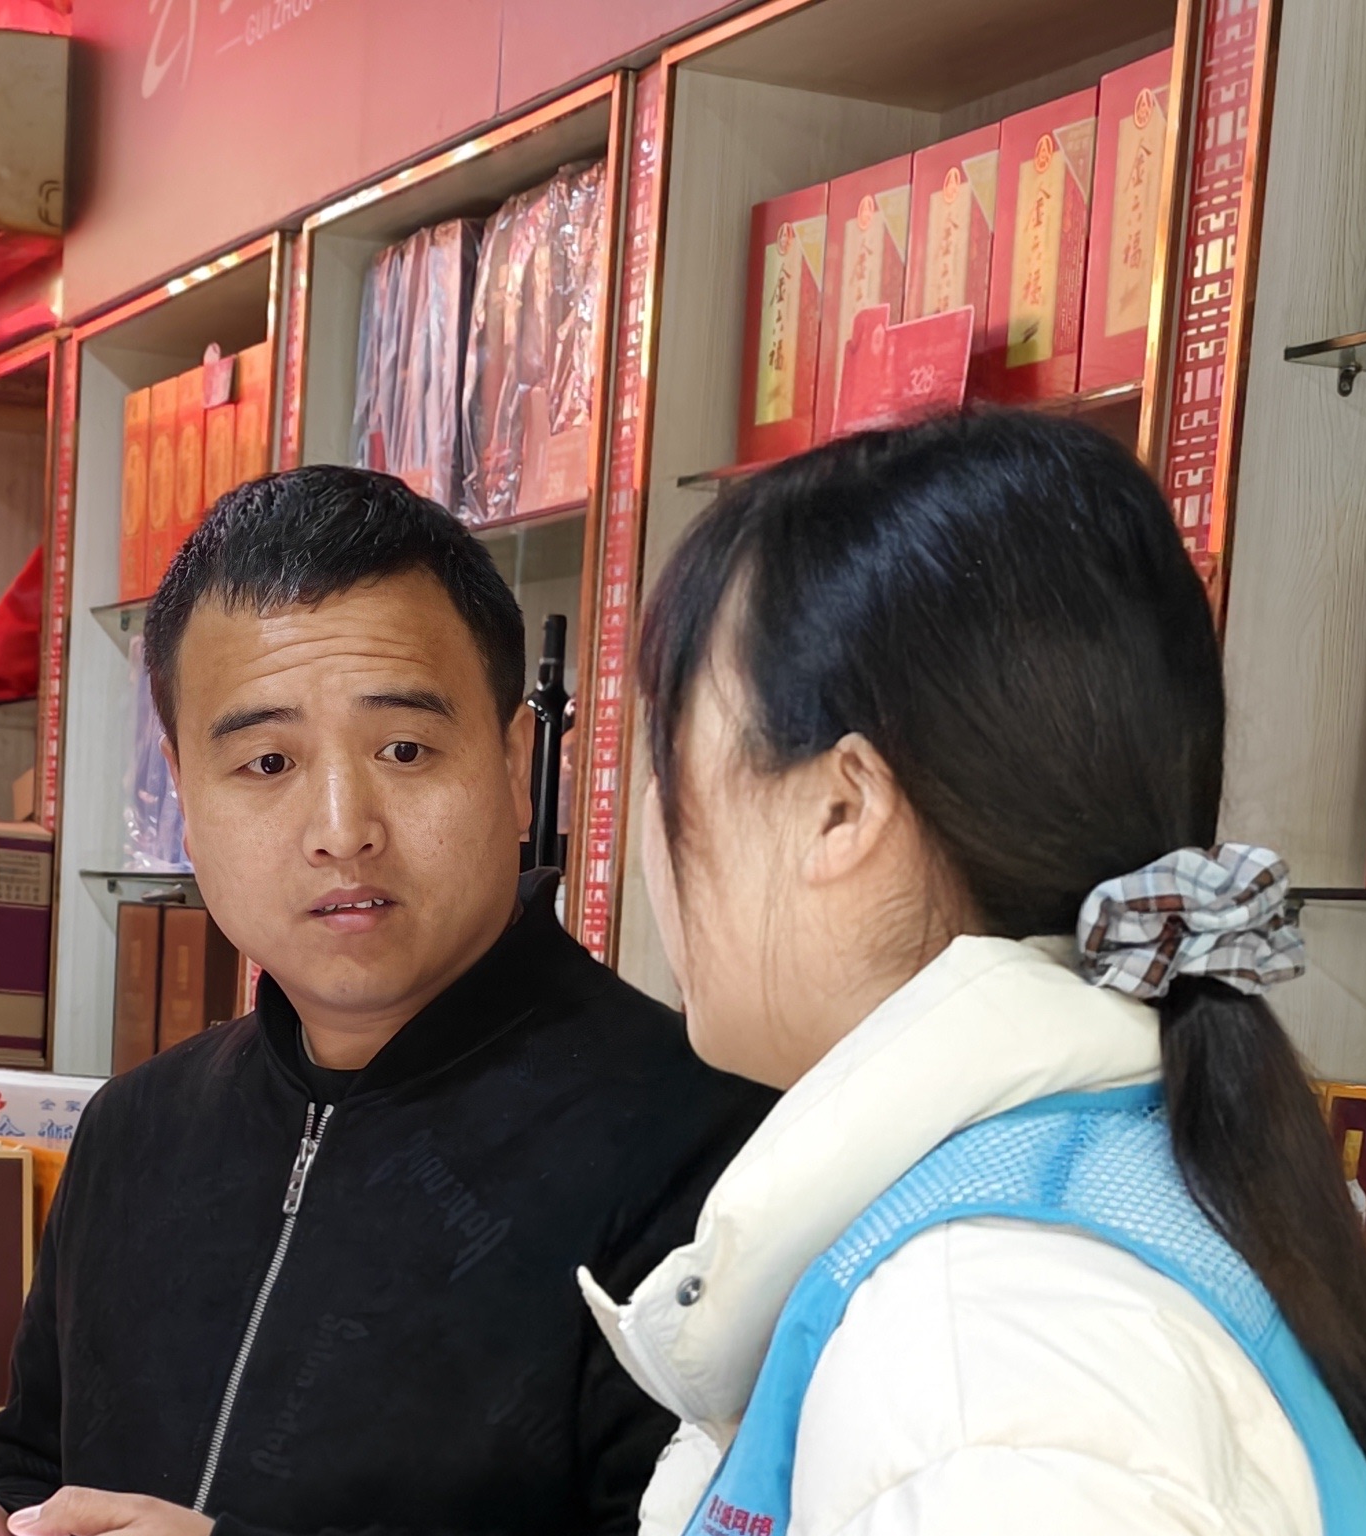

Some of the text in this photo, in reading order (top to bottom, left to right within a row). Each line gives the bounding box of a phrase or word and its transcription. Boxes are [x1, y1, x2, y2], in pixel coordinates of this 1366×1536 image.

[1022, 186, 1051, 306] 金六福
[768, 262, 792, 373] 金六福
